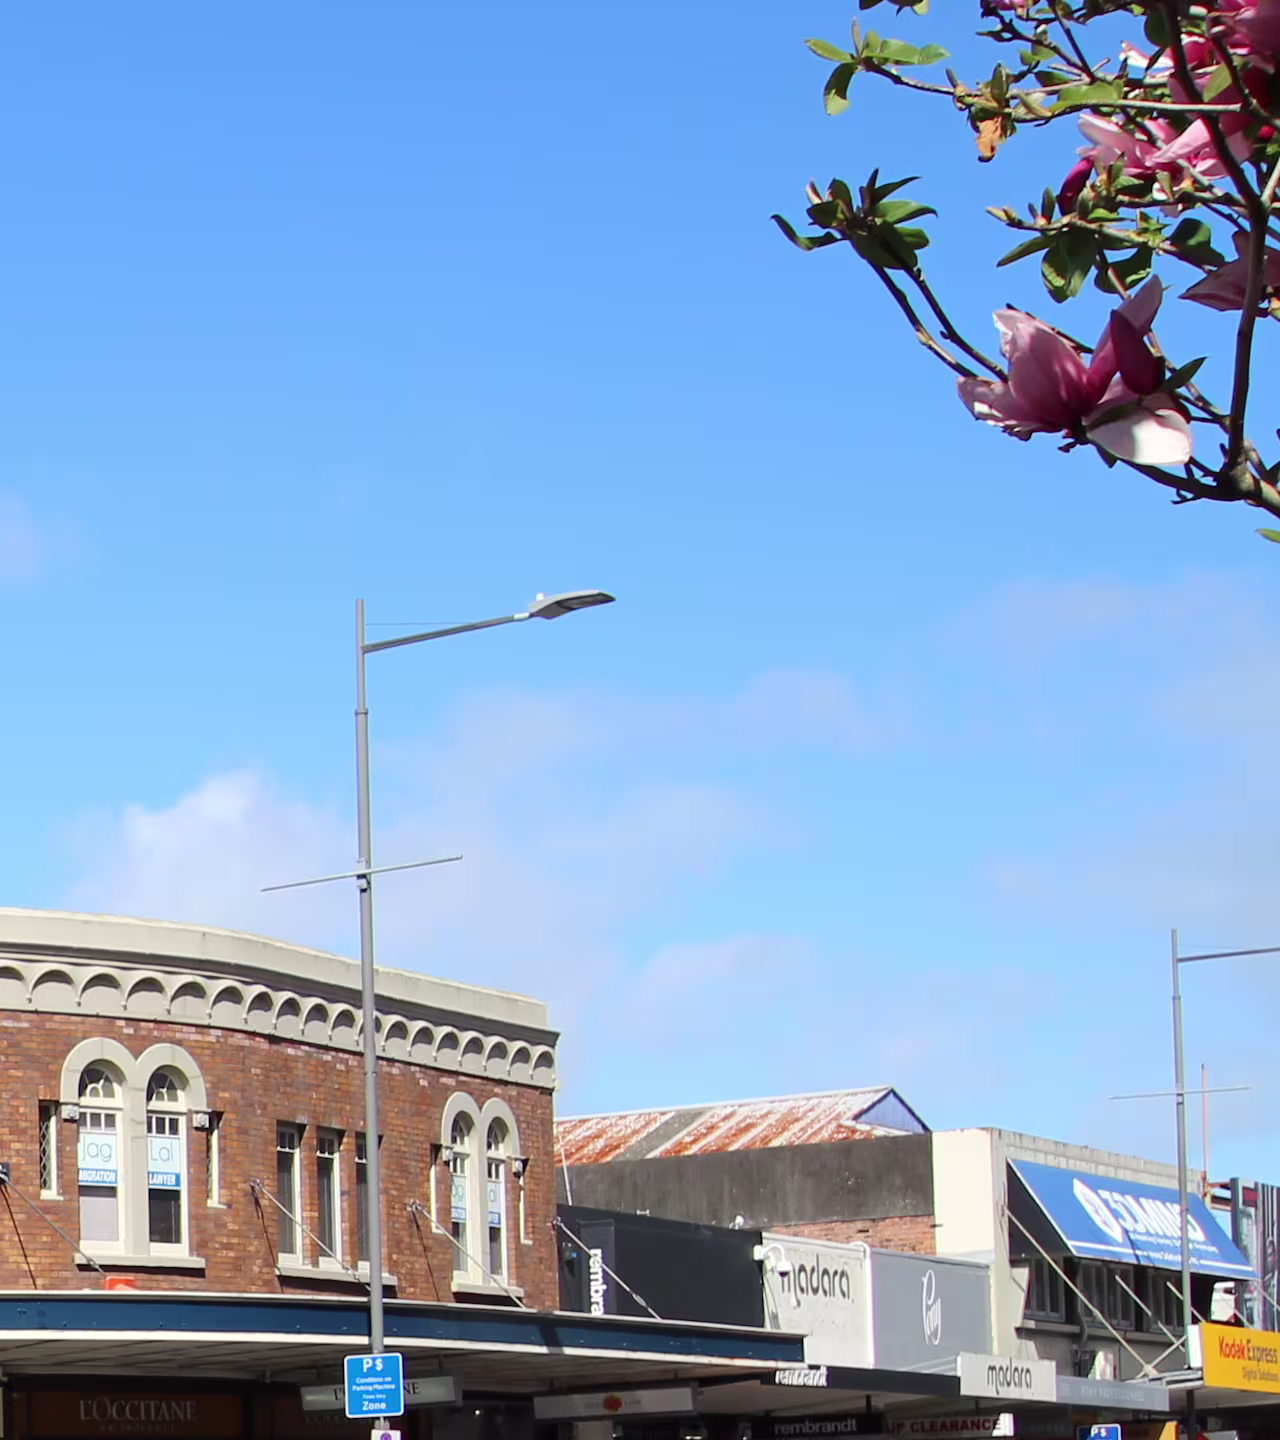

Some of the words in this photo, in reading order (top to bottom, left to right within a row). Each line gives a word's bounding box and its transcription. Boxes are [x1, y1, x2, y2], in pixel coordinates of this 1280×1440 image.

[81, 1135, 112, 1163] Jag
[150, 1138, 174, 1162] Lal
[149, 1172, 176, 1186] LAWYER
[362, 1358, 372, 1372] P
[375, 1358, 384, 1371] $
[775, 1366, 828, 1387] rembrandt
[987, 1359, 1032, 1396] madara
[362, 1401, 386, 1411] Zone
[774, 1418, 857, 1435] rembrandt
[910, 1418, 1001, 1432] CLEARANCE
